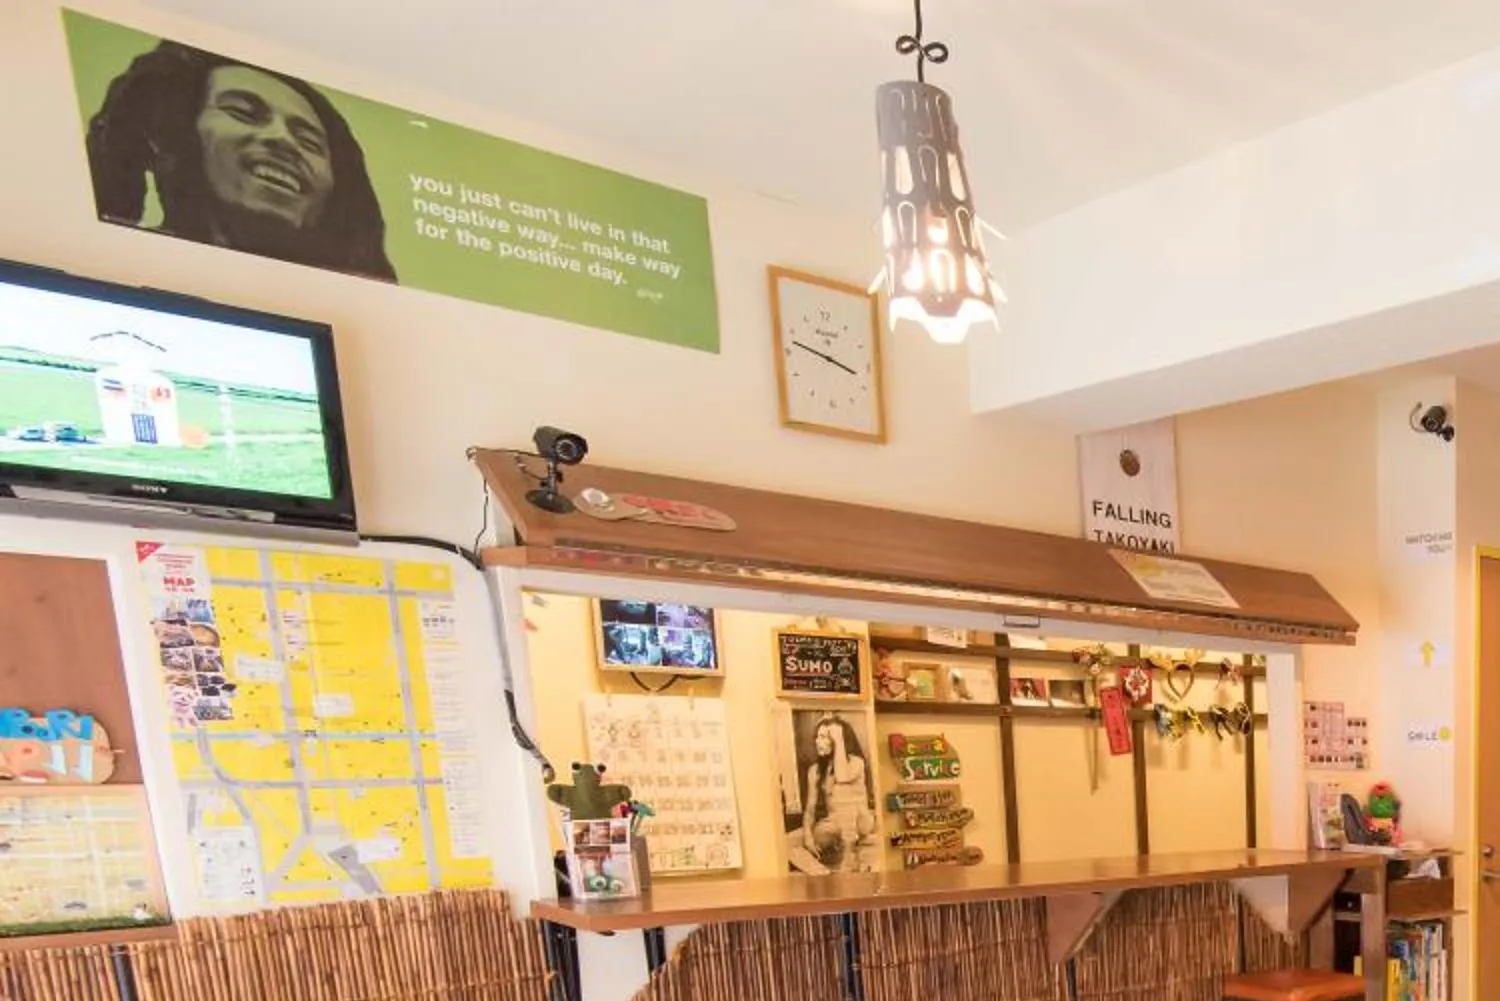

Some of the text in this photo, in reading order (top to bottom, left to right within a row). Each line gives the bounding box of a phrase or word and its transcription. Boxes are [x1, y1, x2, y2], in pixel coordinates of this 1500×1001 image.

[409, 173, 671, 254] you just can't live in that
[412, 196, 682, 279] negative way... make way
[415, 217, 628, 286] for the positive day.
[1092, 500, 1172, 528] FALLING
[1093, 529, 1175, 555] TAKOYAKI
[785, 655, 832, 673] SUMO
